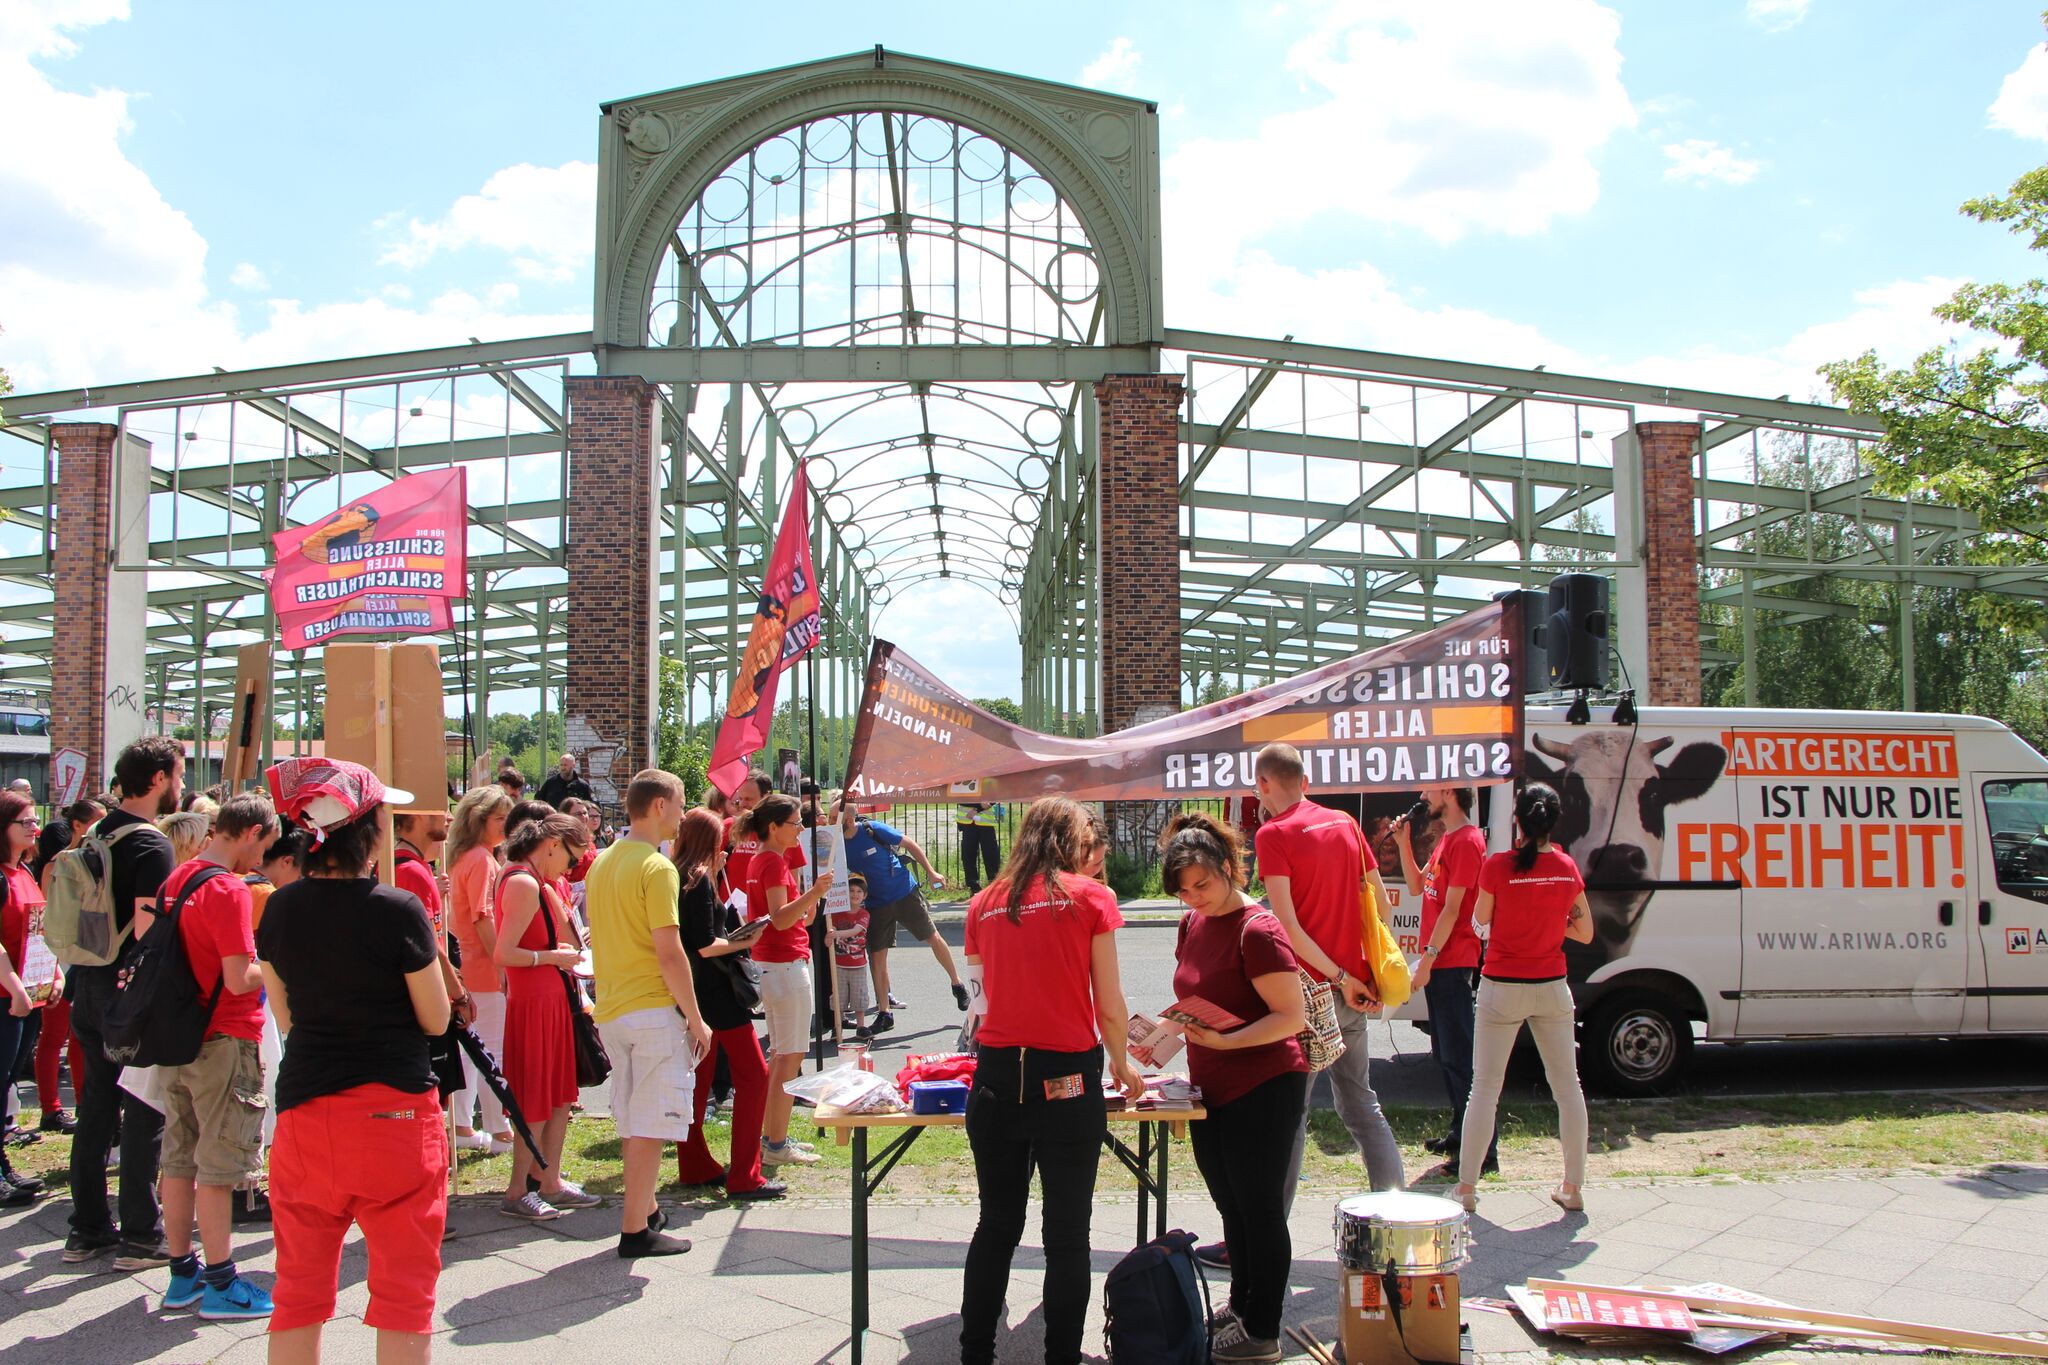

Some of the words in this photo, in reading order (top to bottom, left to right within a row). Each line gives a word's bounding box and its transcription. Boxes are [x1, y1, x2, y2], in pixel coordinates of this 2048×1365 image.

[1730, 737, 1951, 773] ARTGERECHT
[1761, 785, 1809, 818] IST
[1823, 786, 1897, 818] NUR
[1910, 787, 1962, 819] DIE
[1678, 823, 1965, 889] FREIHEIT!
[1393, 914, 1420, 928] NUR
[1757, 932, 1948, 950] WWW.ARIWA.ORG
